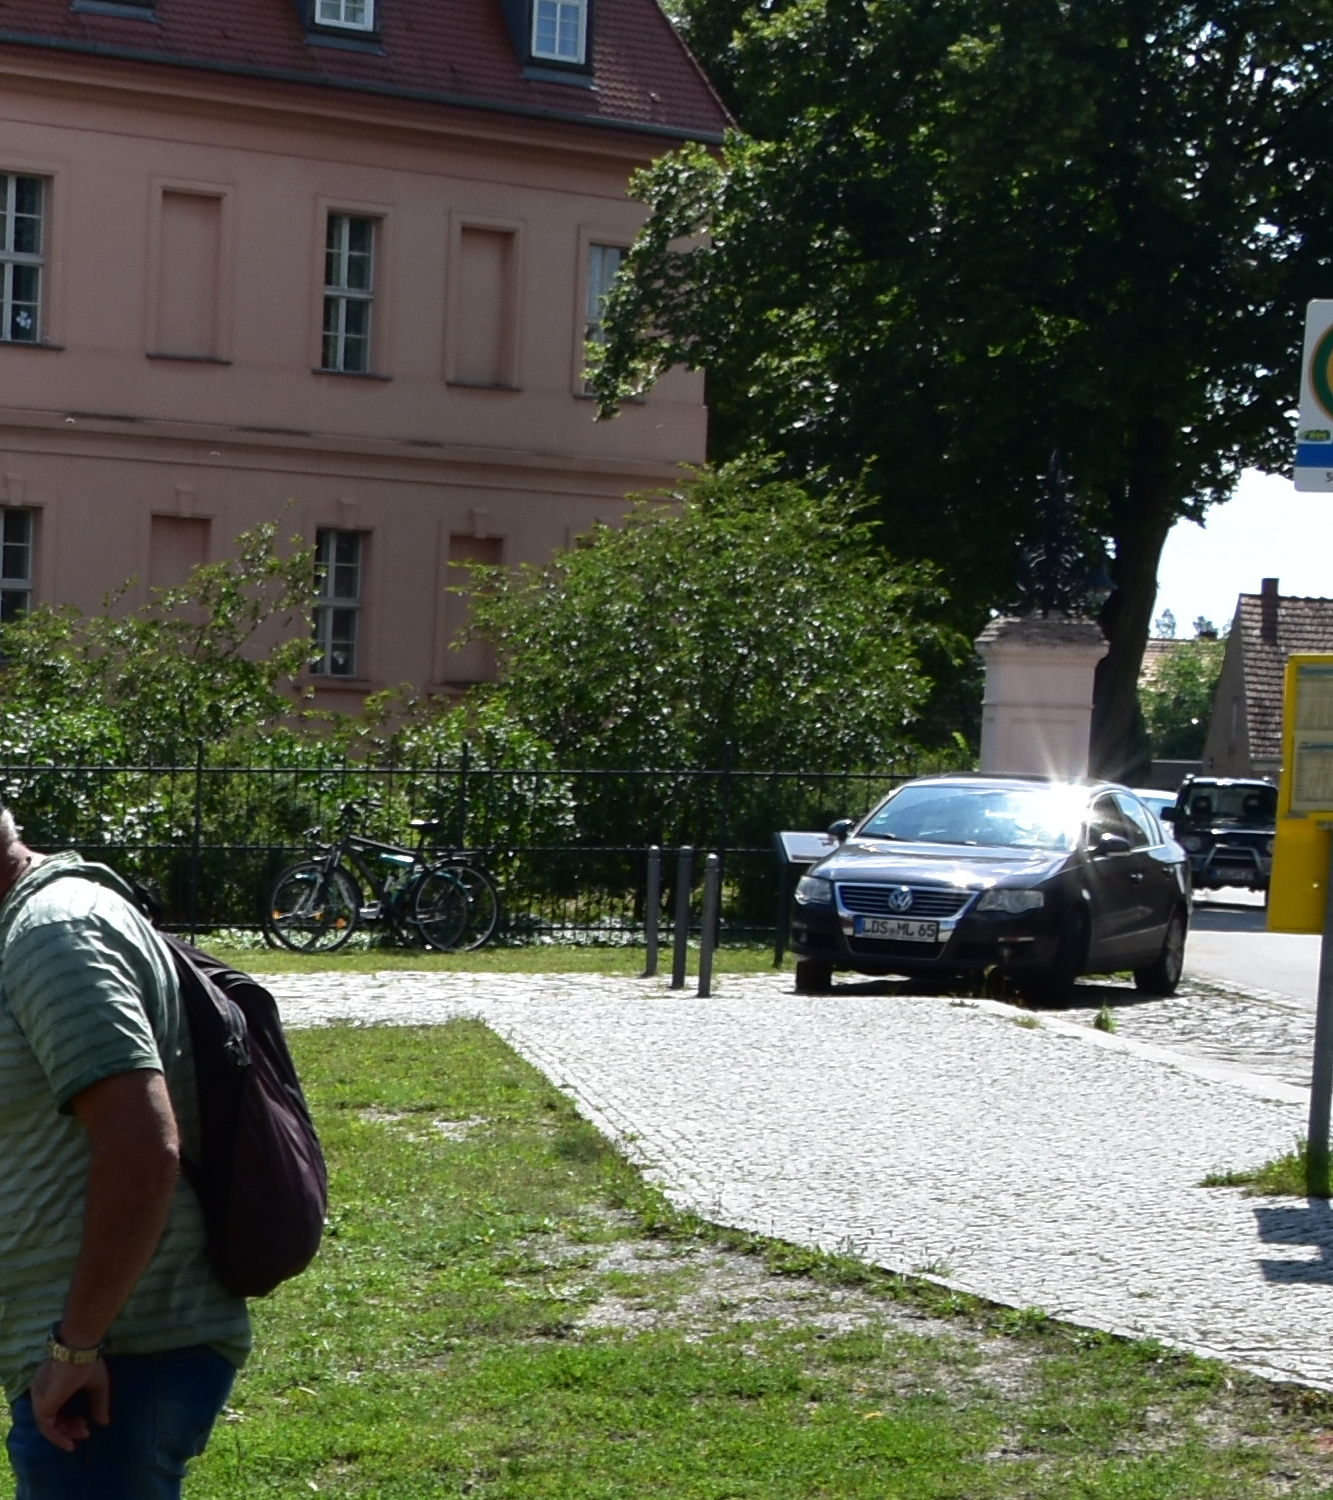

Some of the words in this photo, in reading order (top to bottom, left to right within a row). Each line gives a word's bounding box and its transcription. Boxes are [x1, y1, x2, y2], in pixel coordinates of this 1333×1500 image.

[864, 920, 888, 934] LDS
[896, 922, 914, 936] ML
[918, 924, 935, 937] 65
